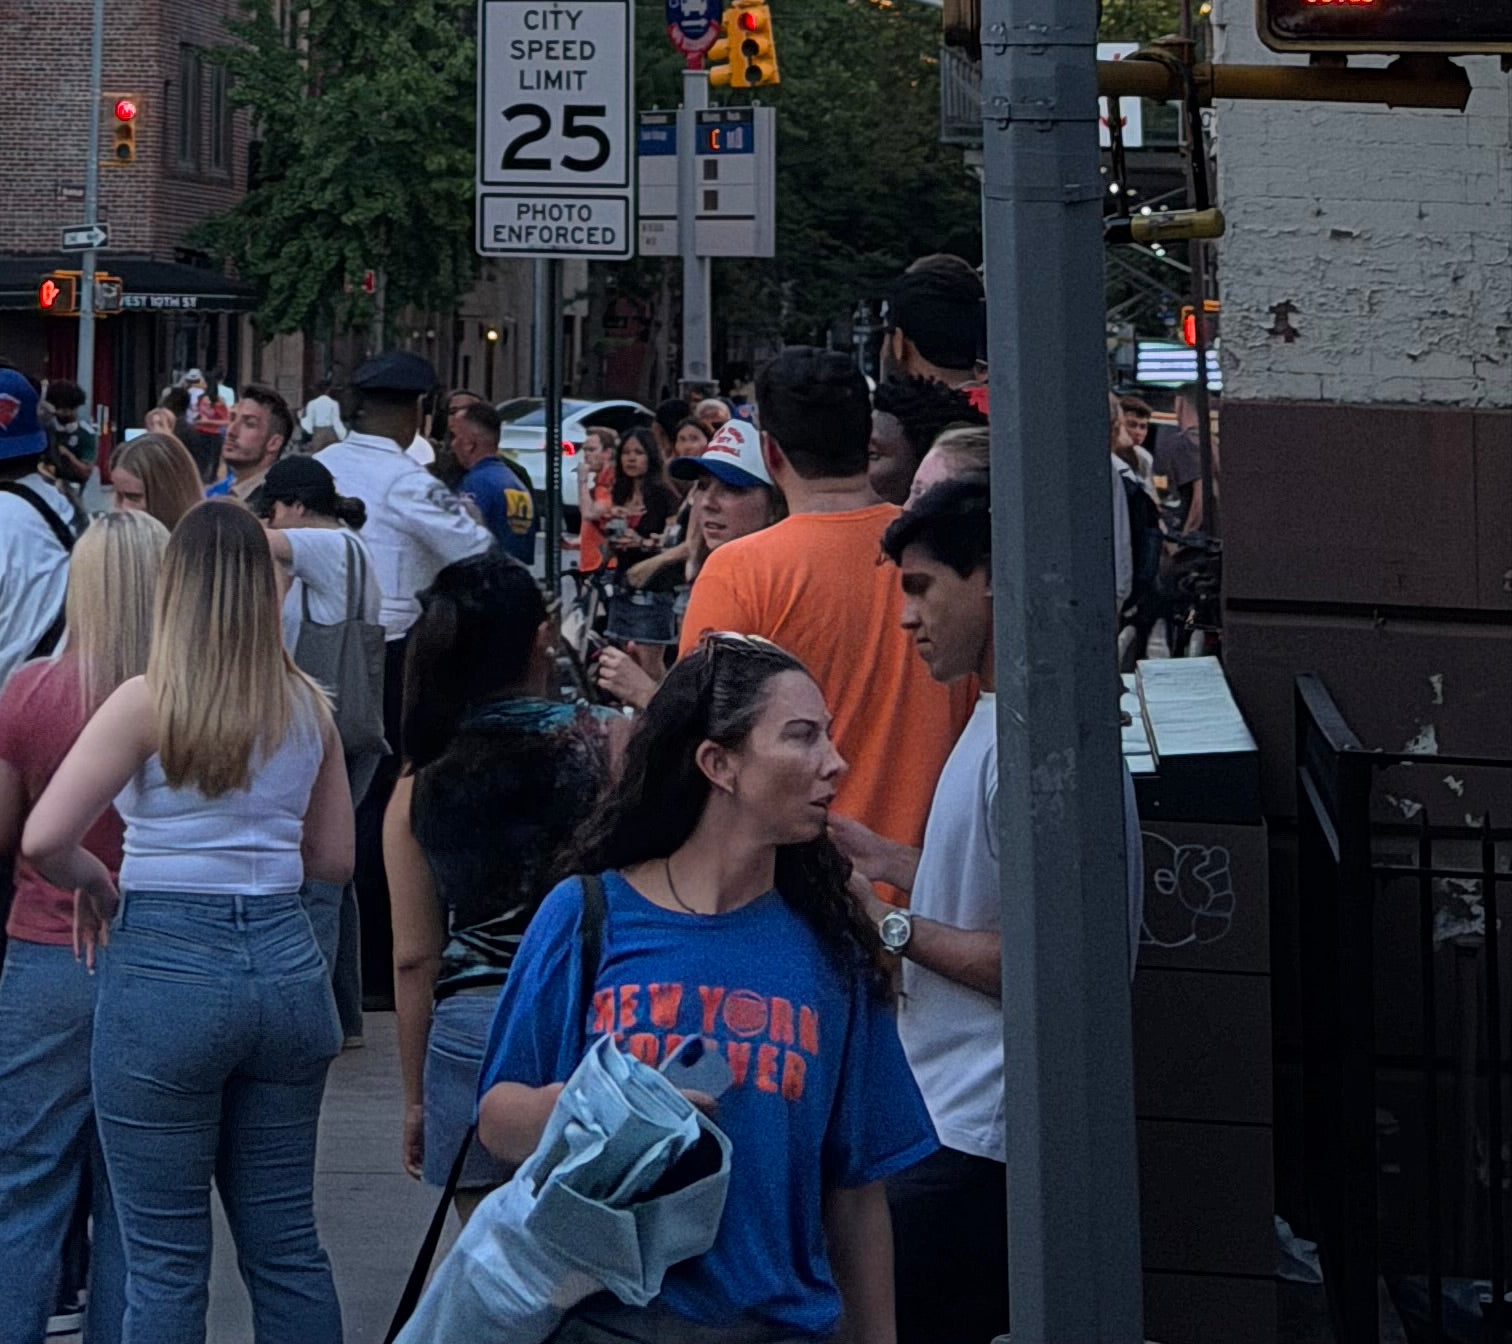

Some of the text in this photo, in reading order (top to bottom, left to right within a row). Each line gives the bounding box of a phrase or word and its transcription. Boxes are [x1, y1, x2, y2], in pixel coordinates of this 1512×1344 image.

[523, 10, 583, 31] CITY
[510, 40, 596, 61] SPEED
[519, 69, 588, 91] LIMIT
[501, 103, 611, 172] 25
[516, 203, 592, 223] PHOTO
[492, 224, 616, 245] ENFORCED
[593, 982, 683, 1034] NEW
